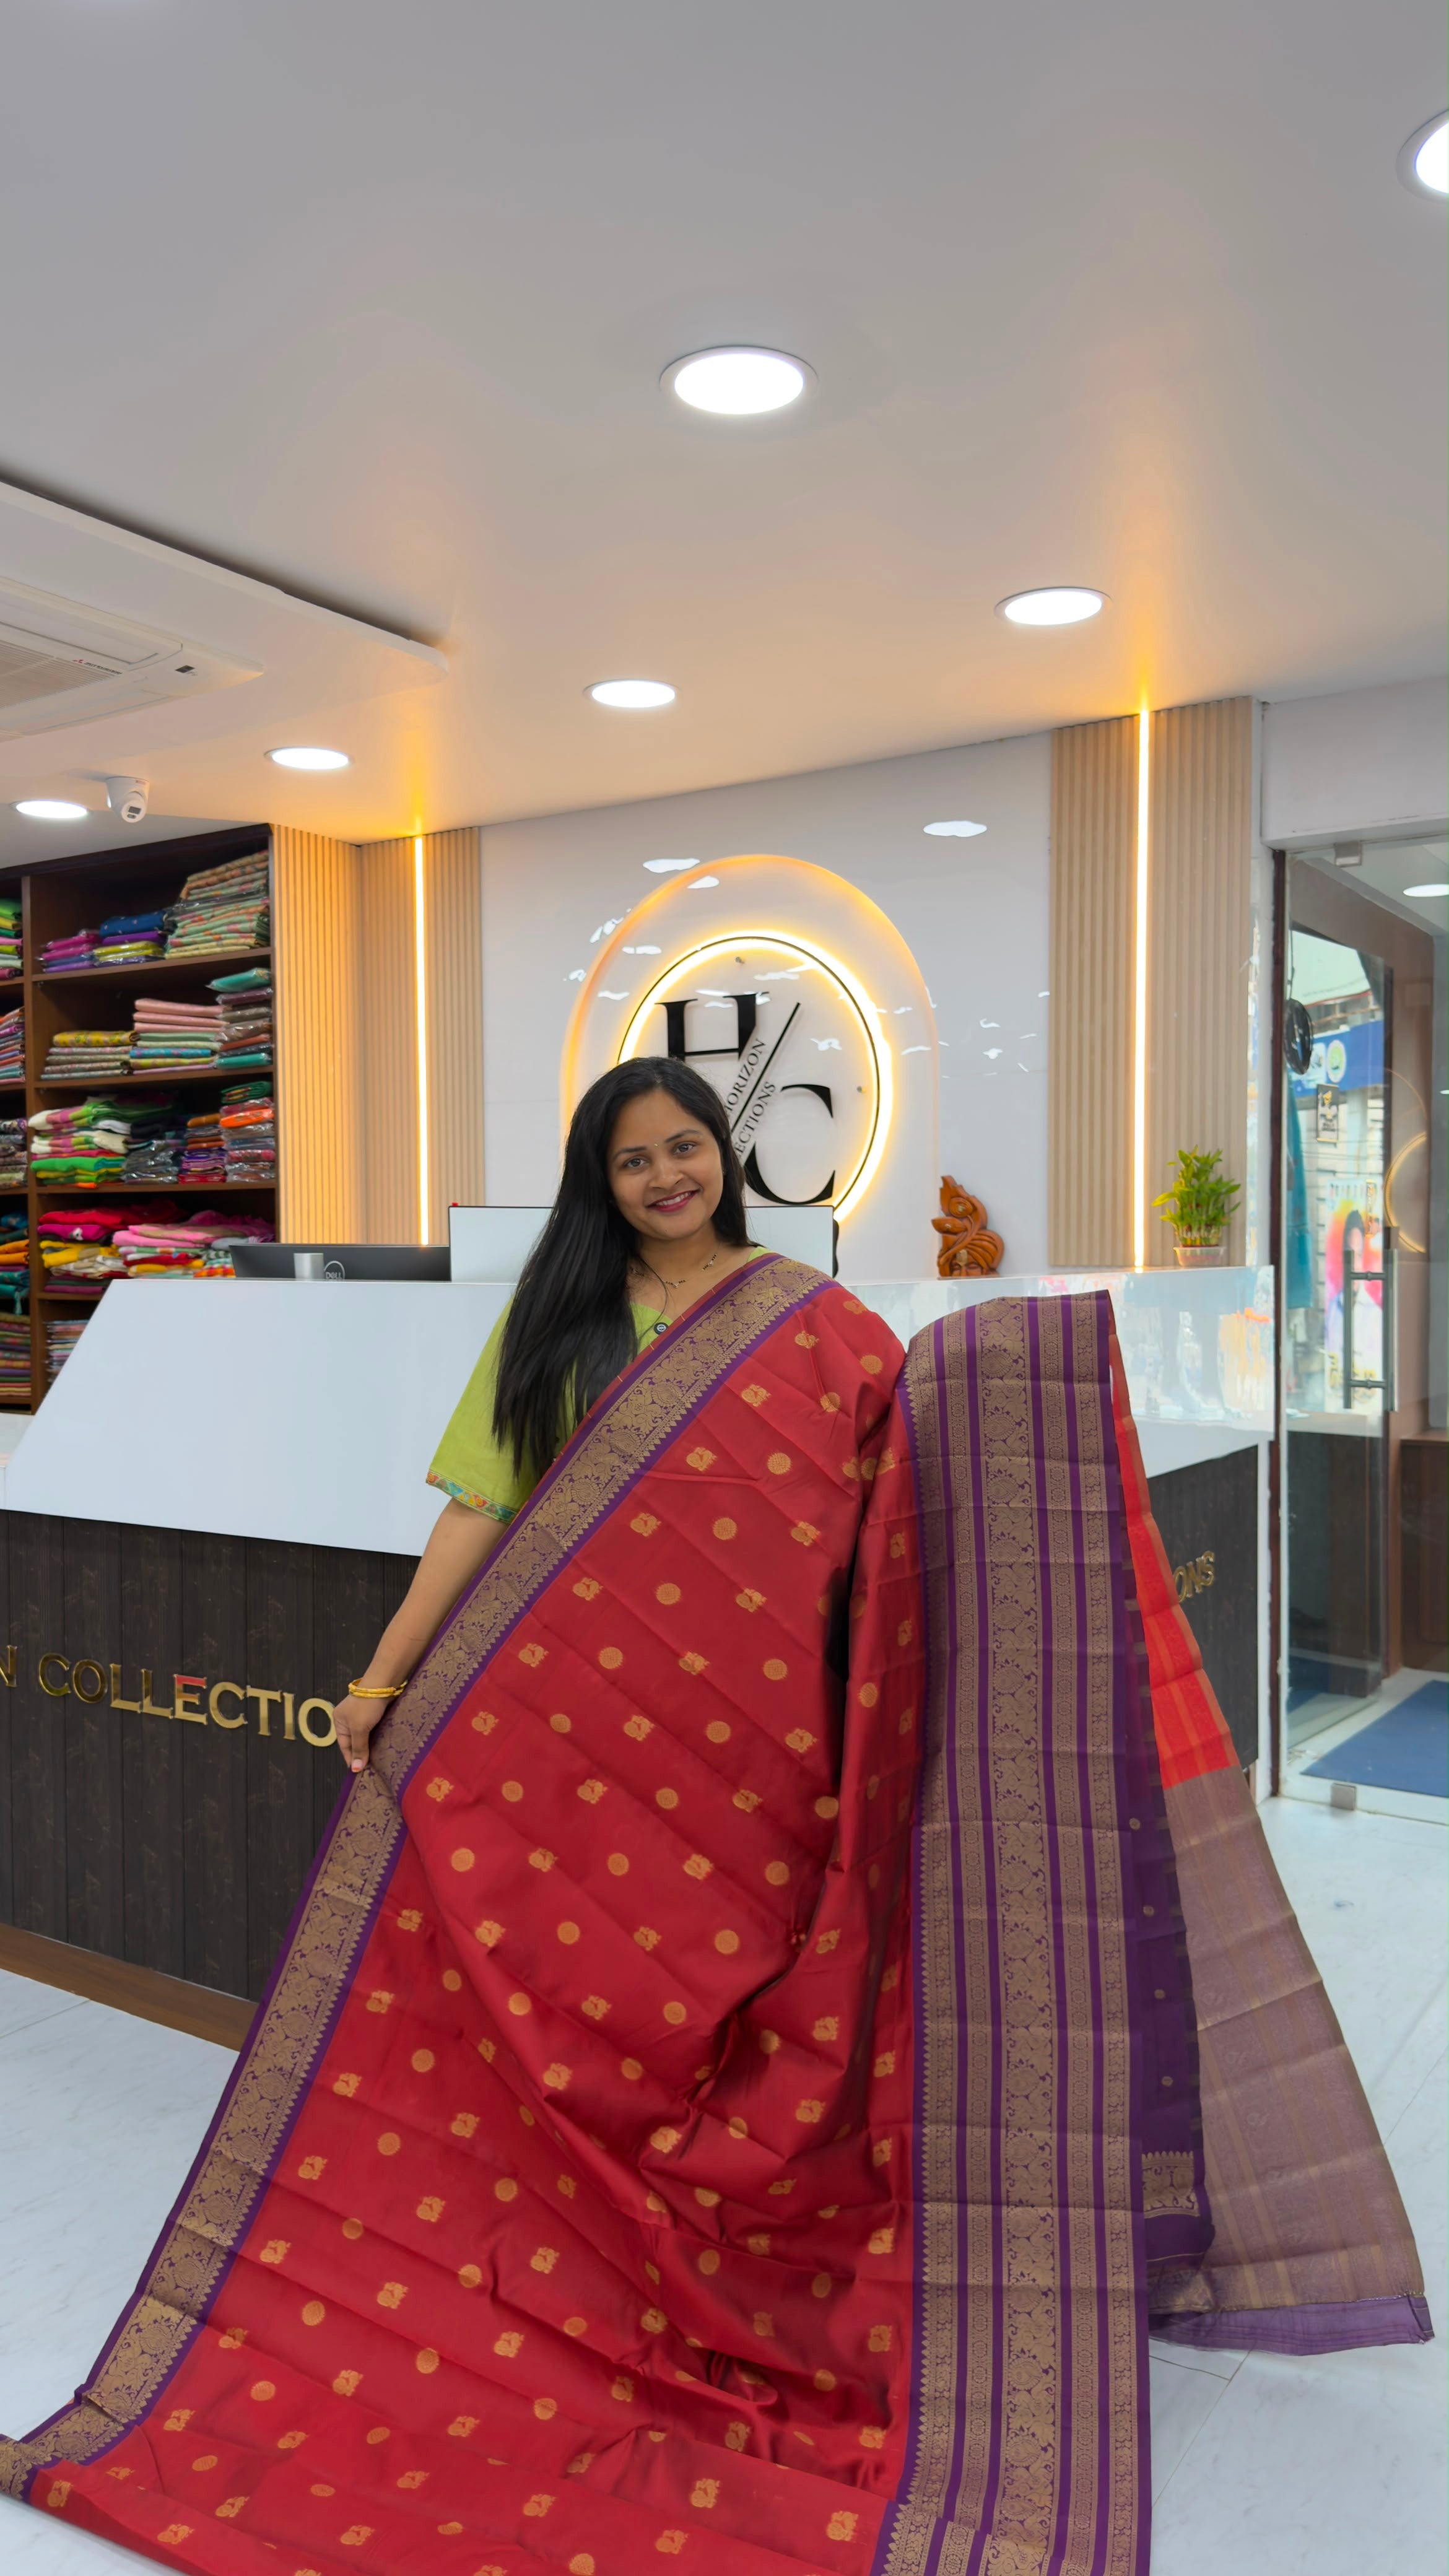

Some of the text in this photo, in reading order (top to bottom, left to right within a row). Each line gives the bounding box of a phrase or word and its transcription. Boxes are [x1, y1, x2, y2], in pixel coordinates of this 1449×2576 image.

[734, 1081, 776, 1159] ECTIONS
[1173, 1551, 1216, 1603] ONS
[38, 1652, 337, 1747] COLLECTIO
